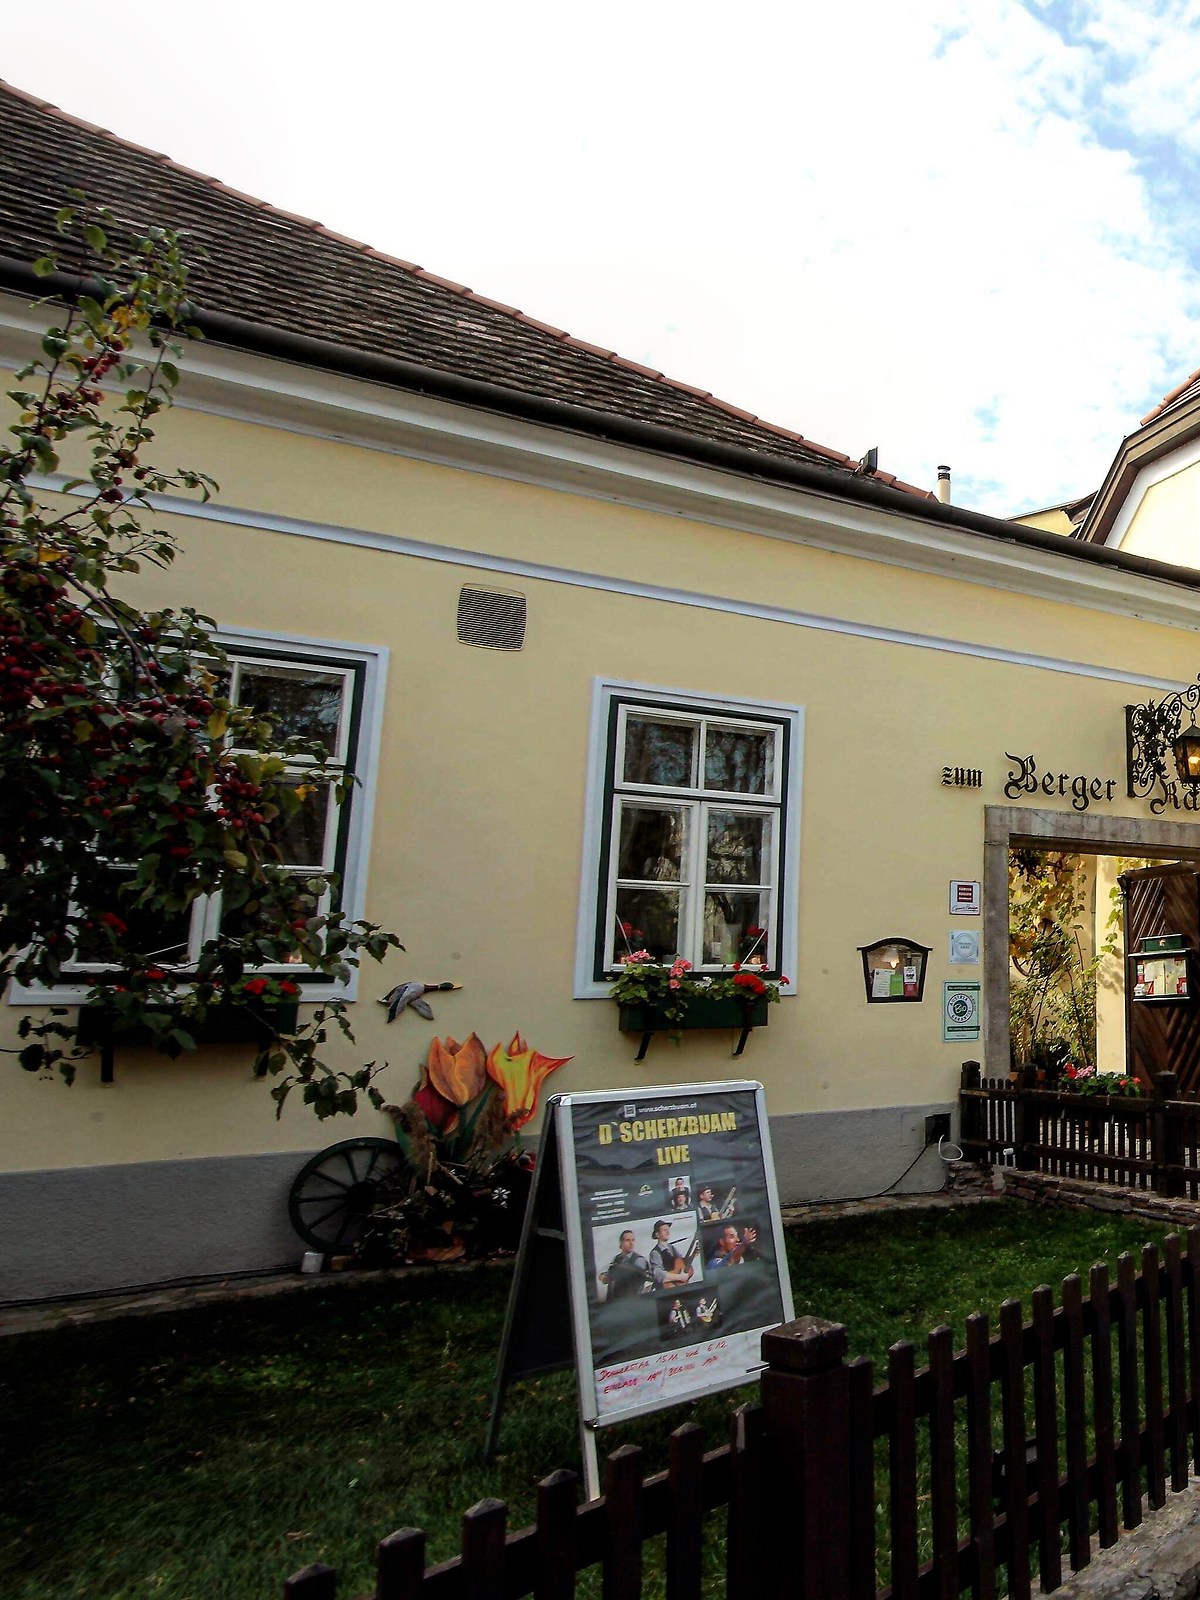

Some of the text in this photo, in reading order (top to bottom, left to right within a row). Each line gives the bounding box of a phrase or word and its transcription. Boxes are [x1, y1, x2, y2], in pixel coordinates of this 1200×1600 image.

[941, 765, 983, 788] zum
[1003, 751, 1117, 812] Berger
[656, 1144, 691, 1166] LIVE
